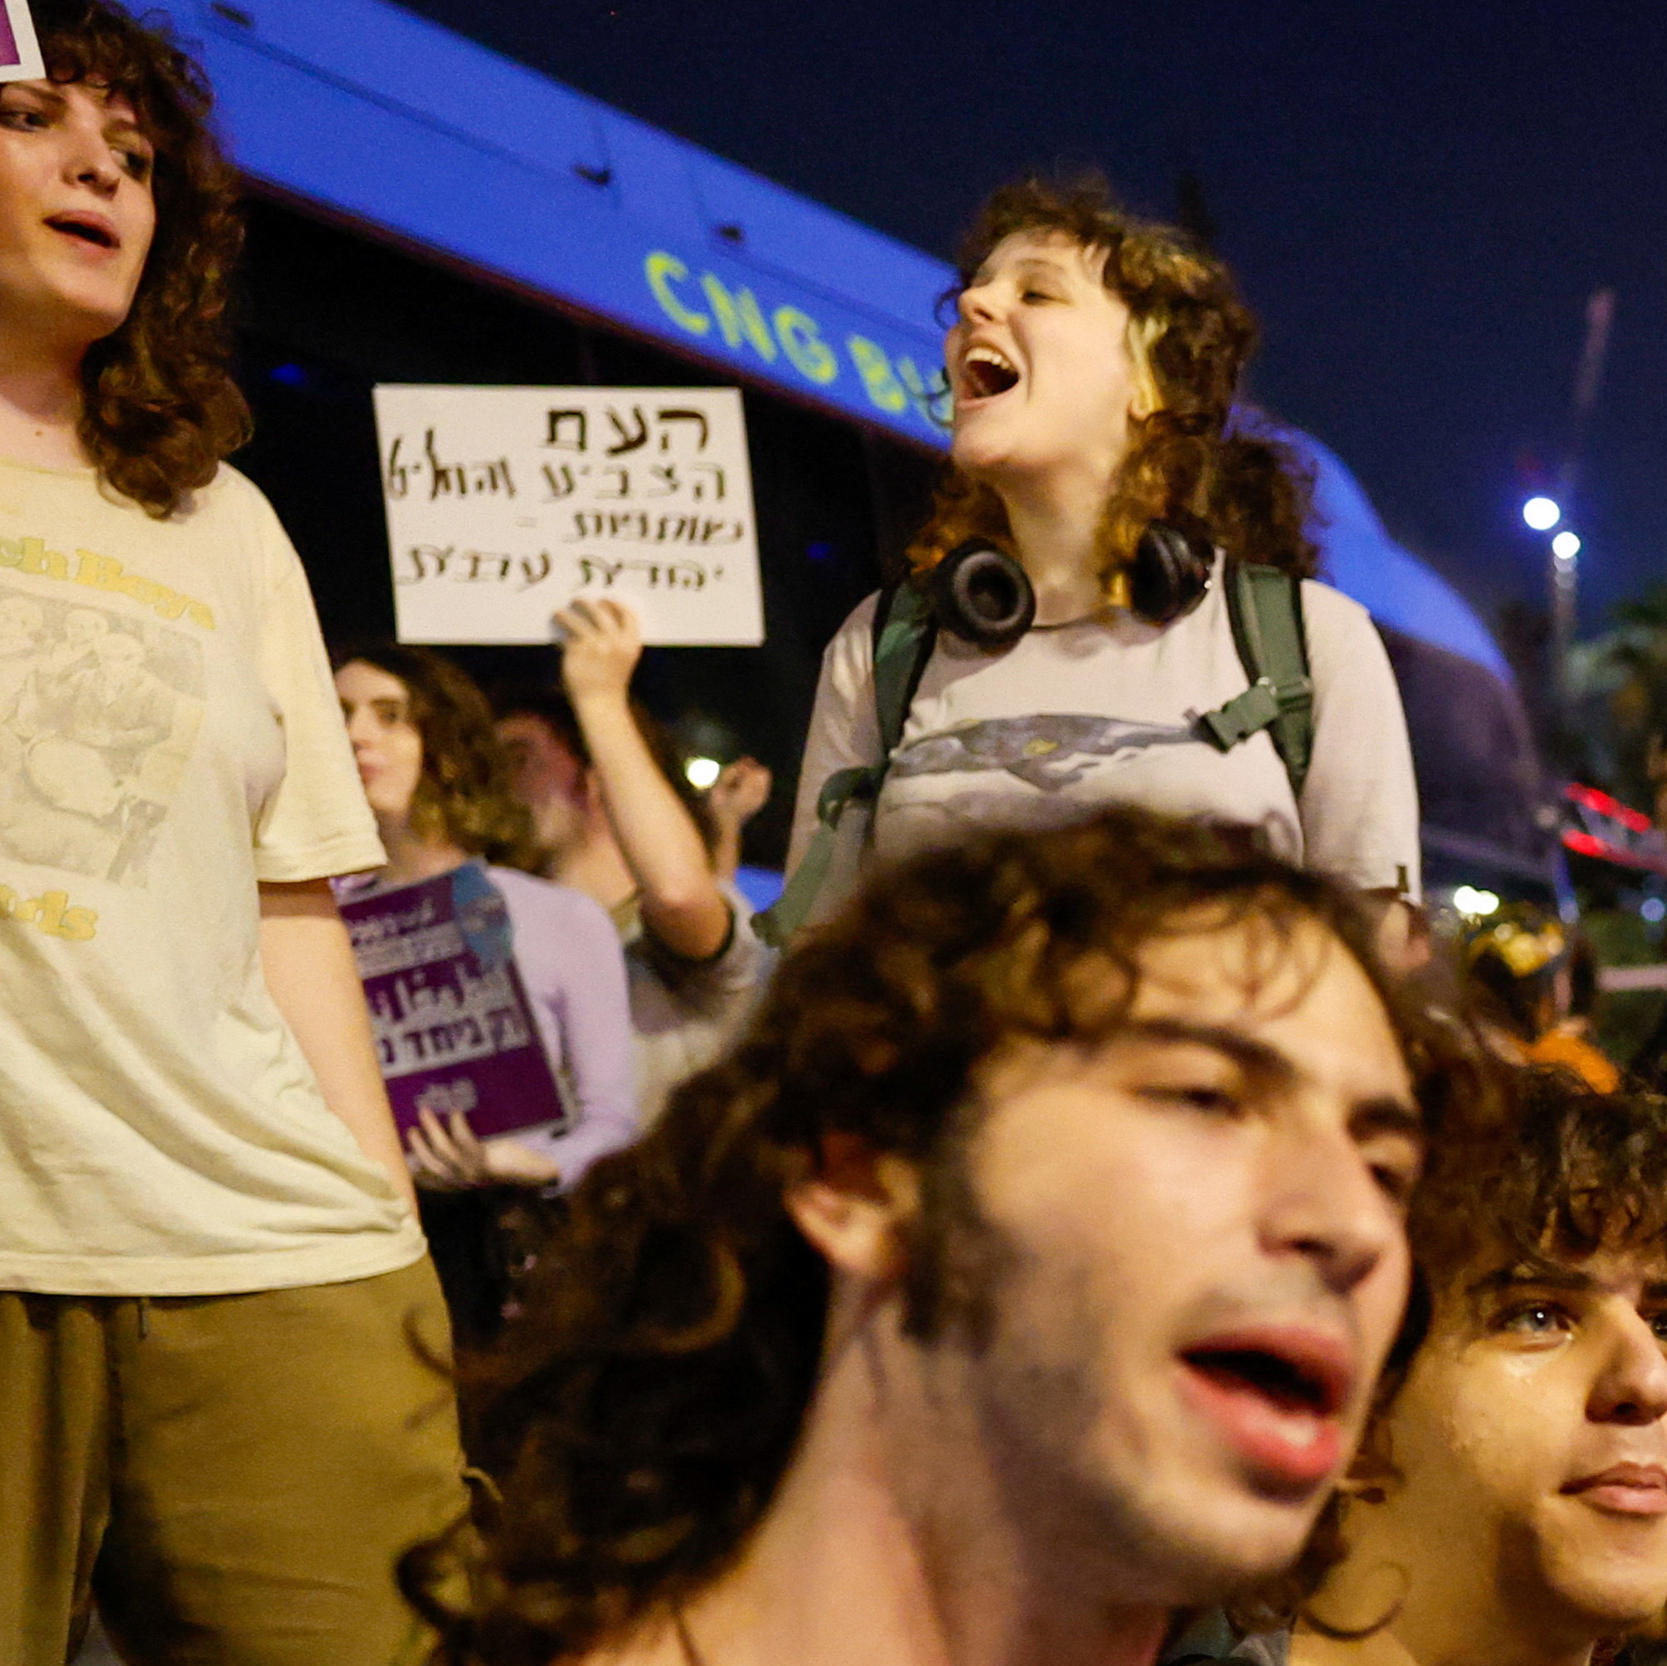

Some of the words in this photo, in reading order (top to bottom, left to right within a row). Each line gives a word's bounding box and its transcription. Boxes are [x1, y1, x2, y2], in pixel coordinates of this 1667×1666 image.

[645, 251, 838, 385] CNG
[541, 404, 710, 456] העם
[541, 461, 727, 502] הצביע
